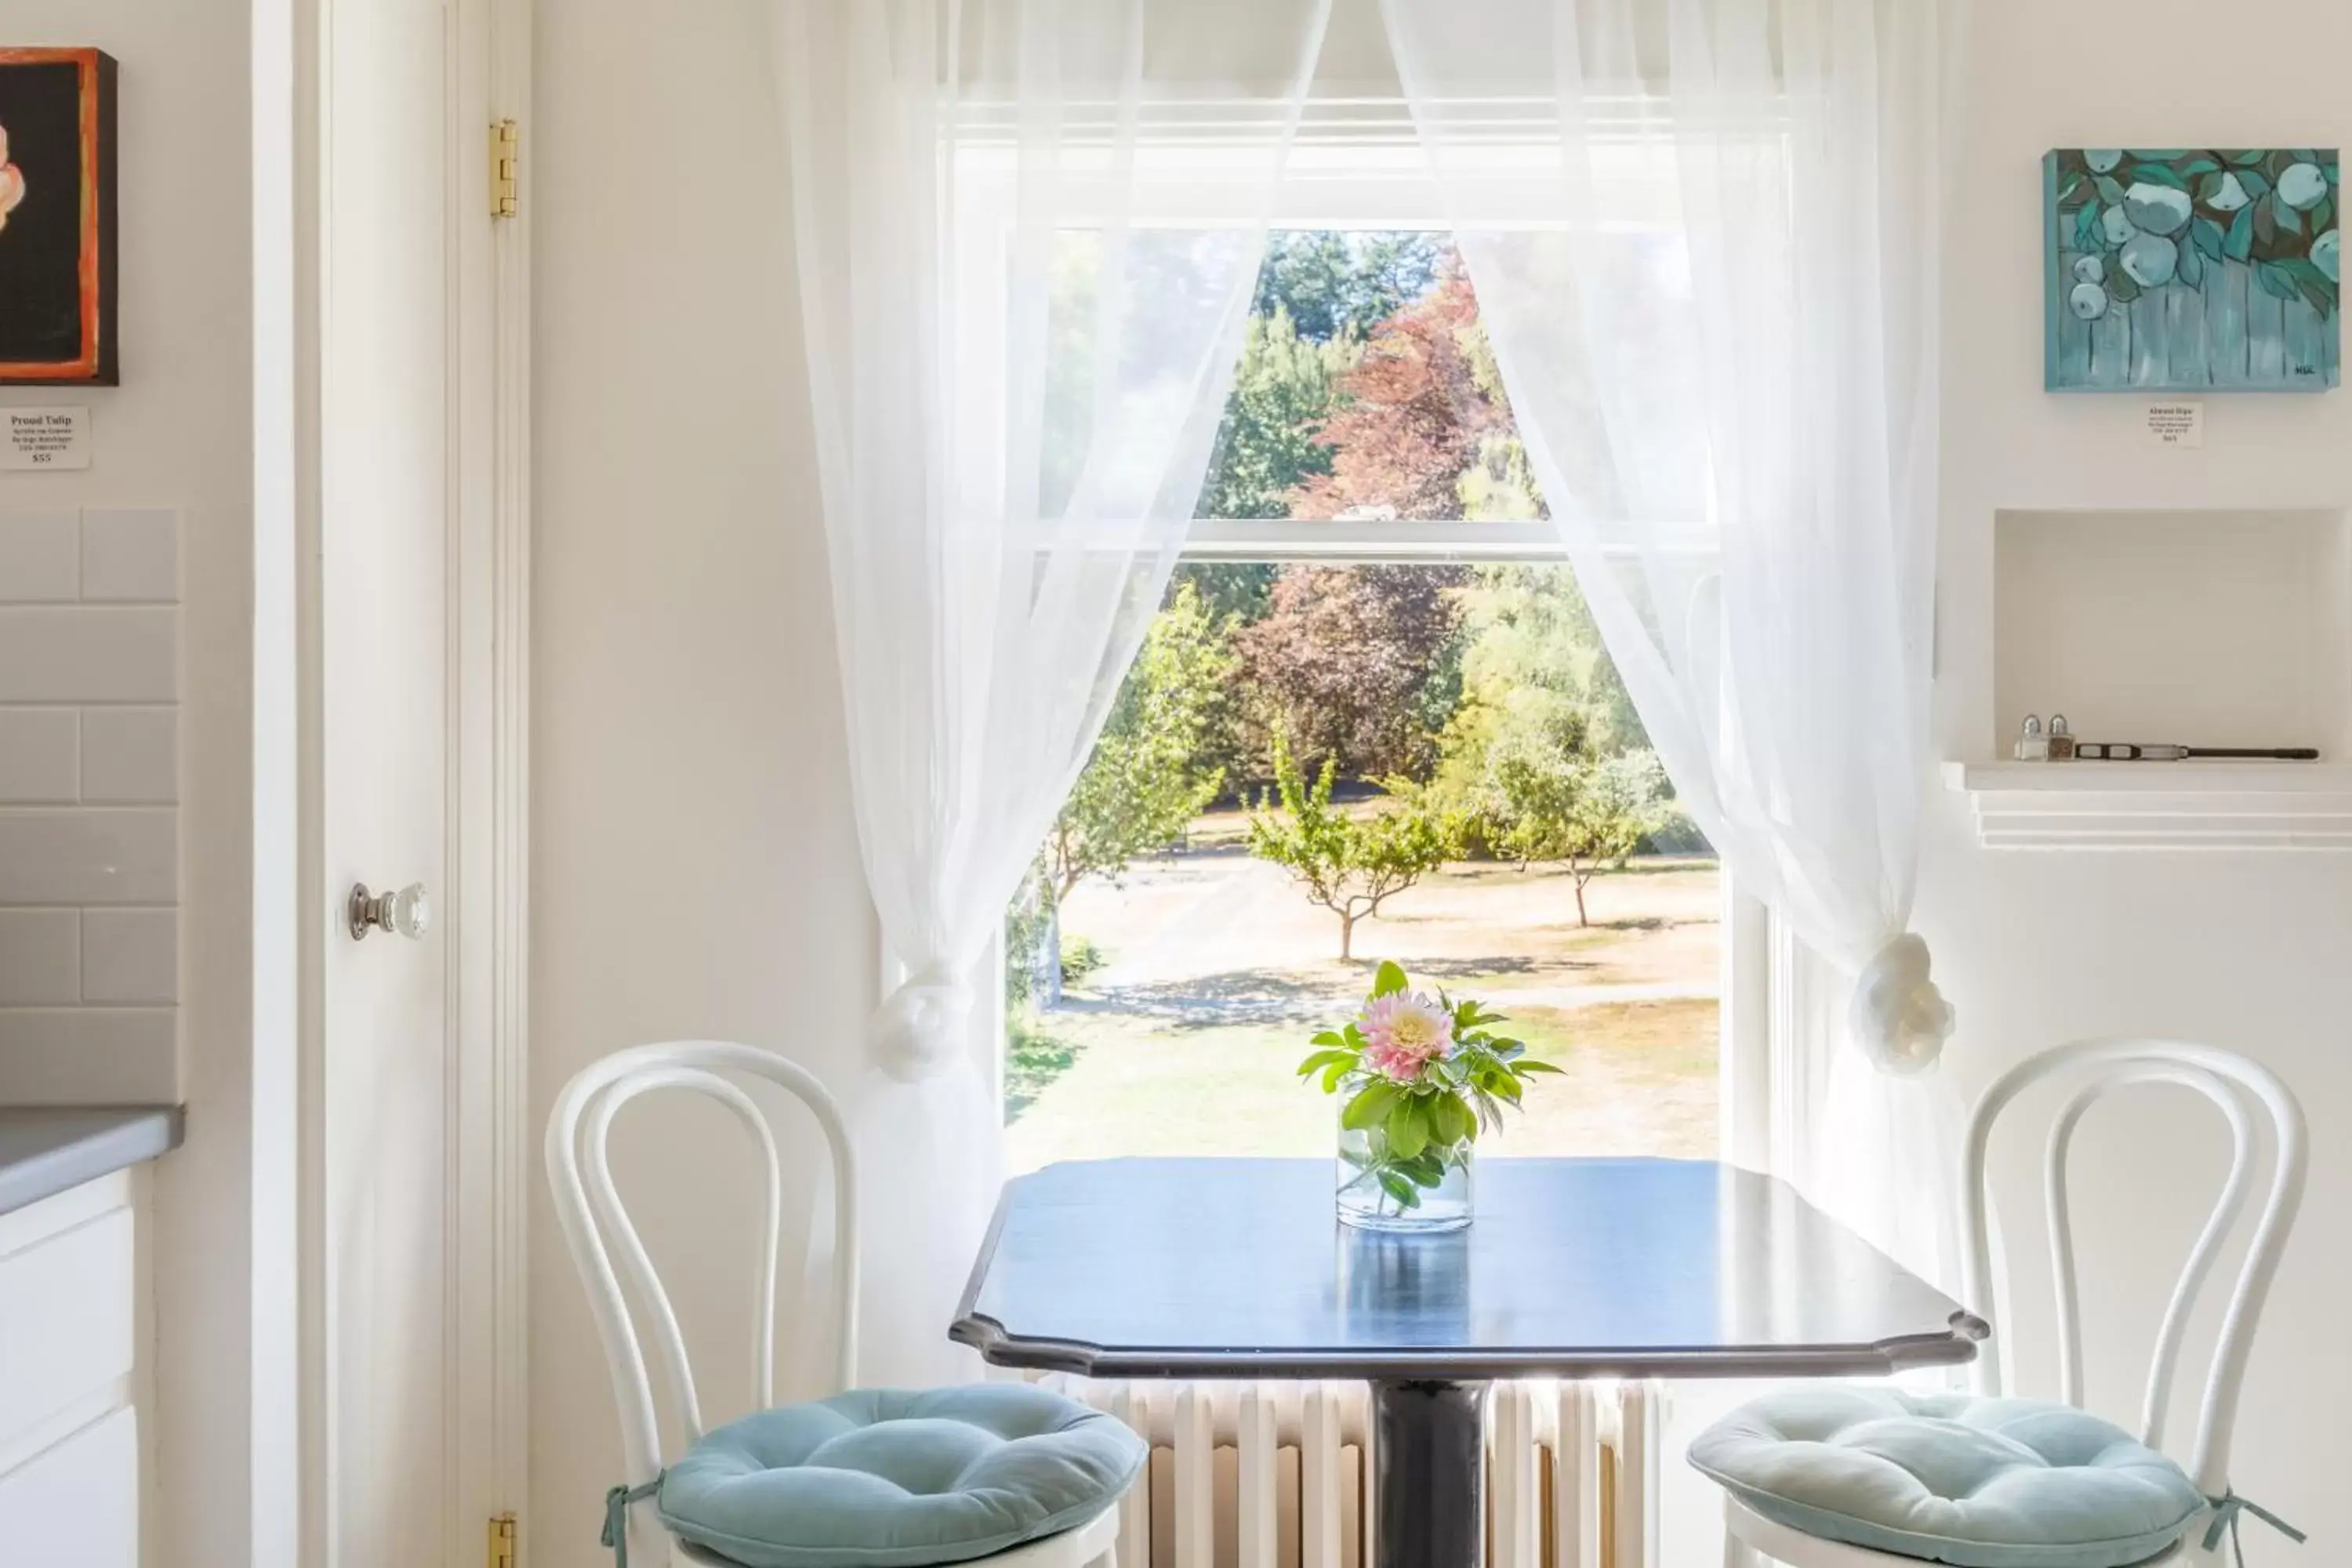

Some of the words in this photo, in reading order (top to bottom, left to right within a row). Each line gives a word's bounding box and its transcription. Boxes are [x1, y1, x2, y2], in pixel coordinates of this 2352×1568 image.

[11, 416, 43, 425] Proud
[45, 416, 72, 426] Tulip
[32, 454, 52, 463] $55
